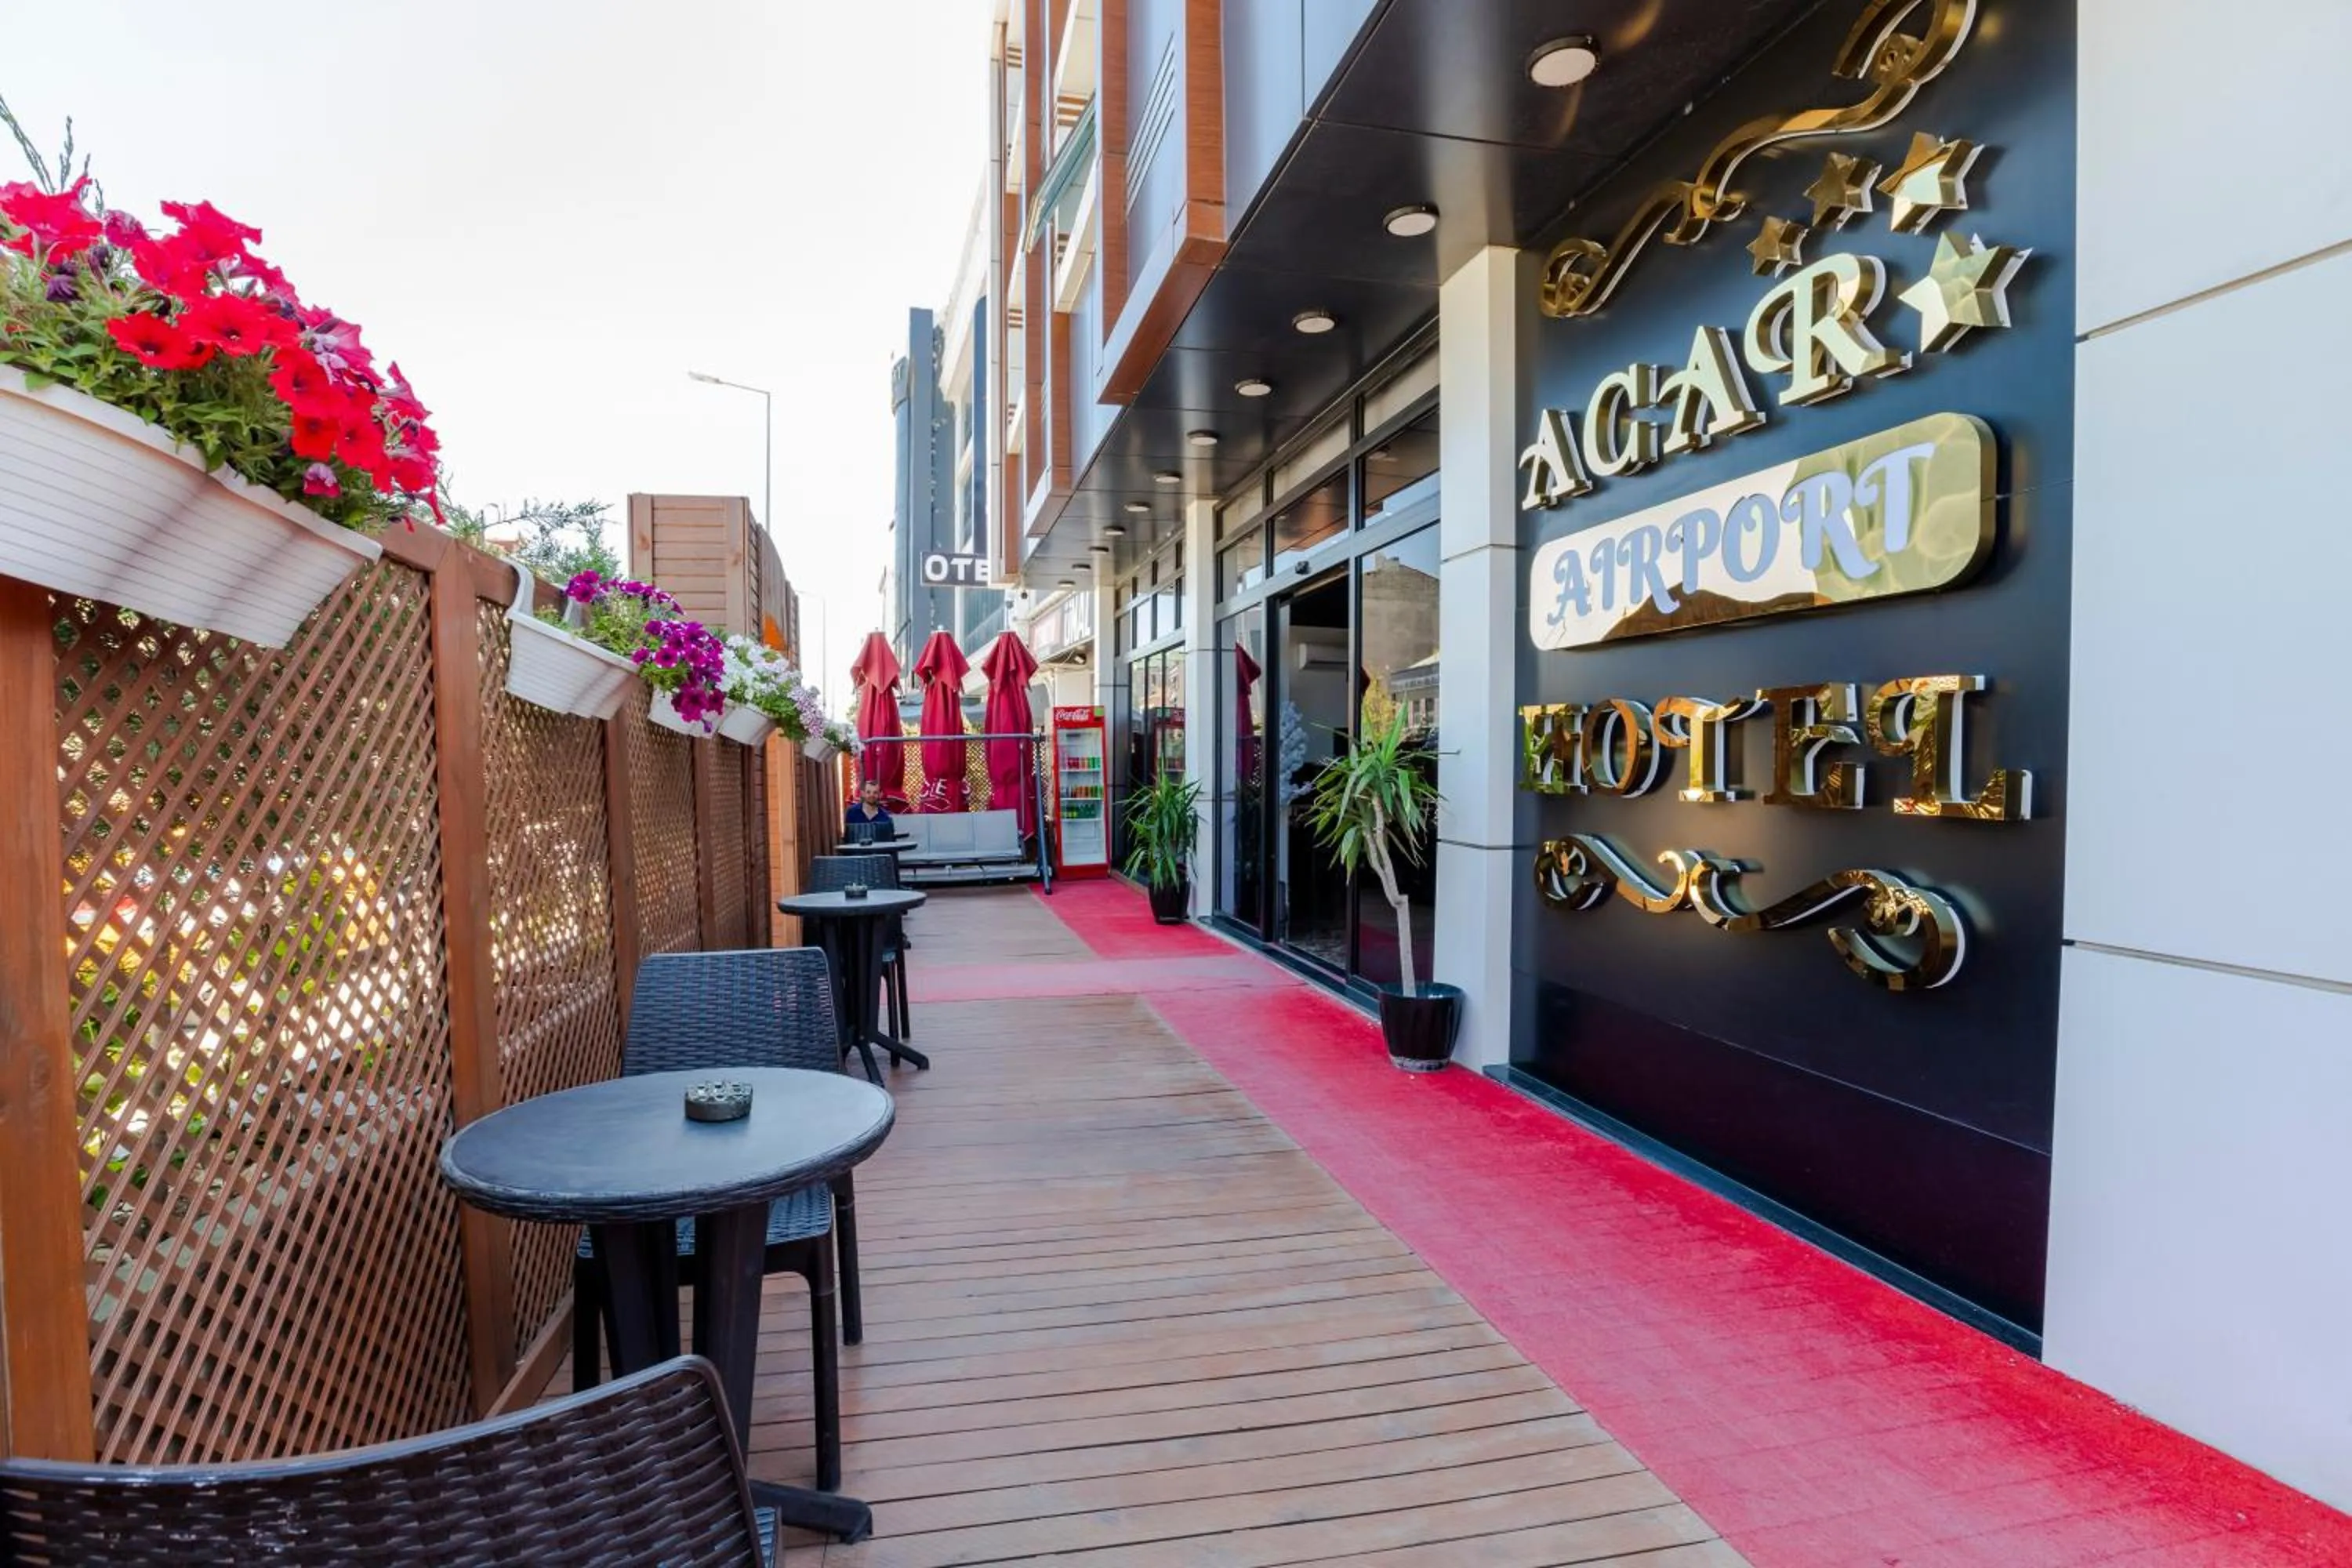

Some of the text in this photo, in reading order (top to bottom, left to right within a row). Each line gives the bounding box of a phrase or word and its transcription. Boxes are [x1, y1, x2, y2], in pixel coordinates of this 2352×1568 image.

[1519, 252, 1913, 511] ACAR
[1548, 442, 1935, 626] AIRPORT
[1518, 674, 2031, 821] HOTEL
